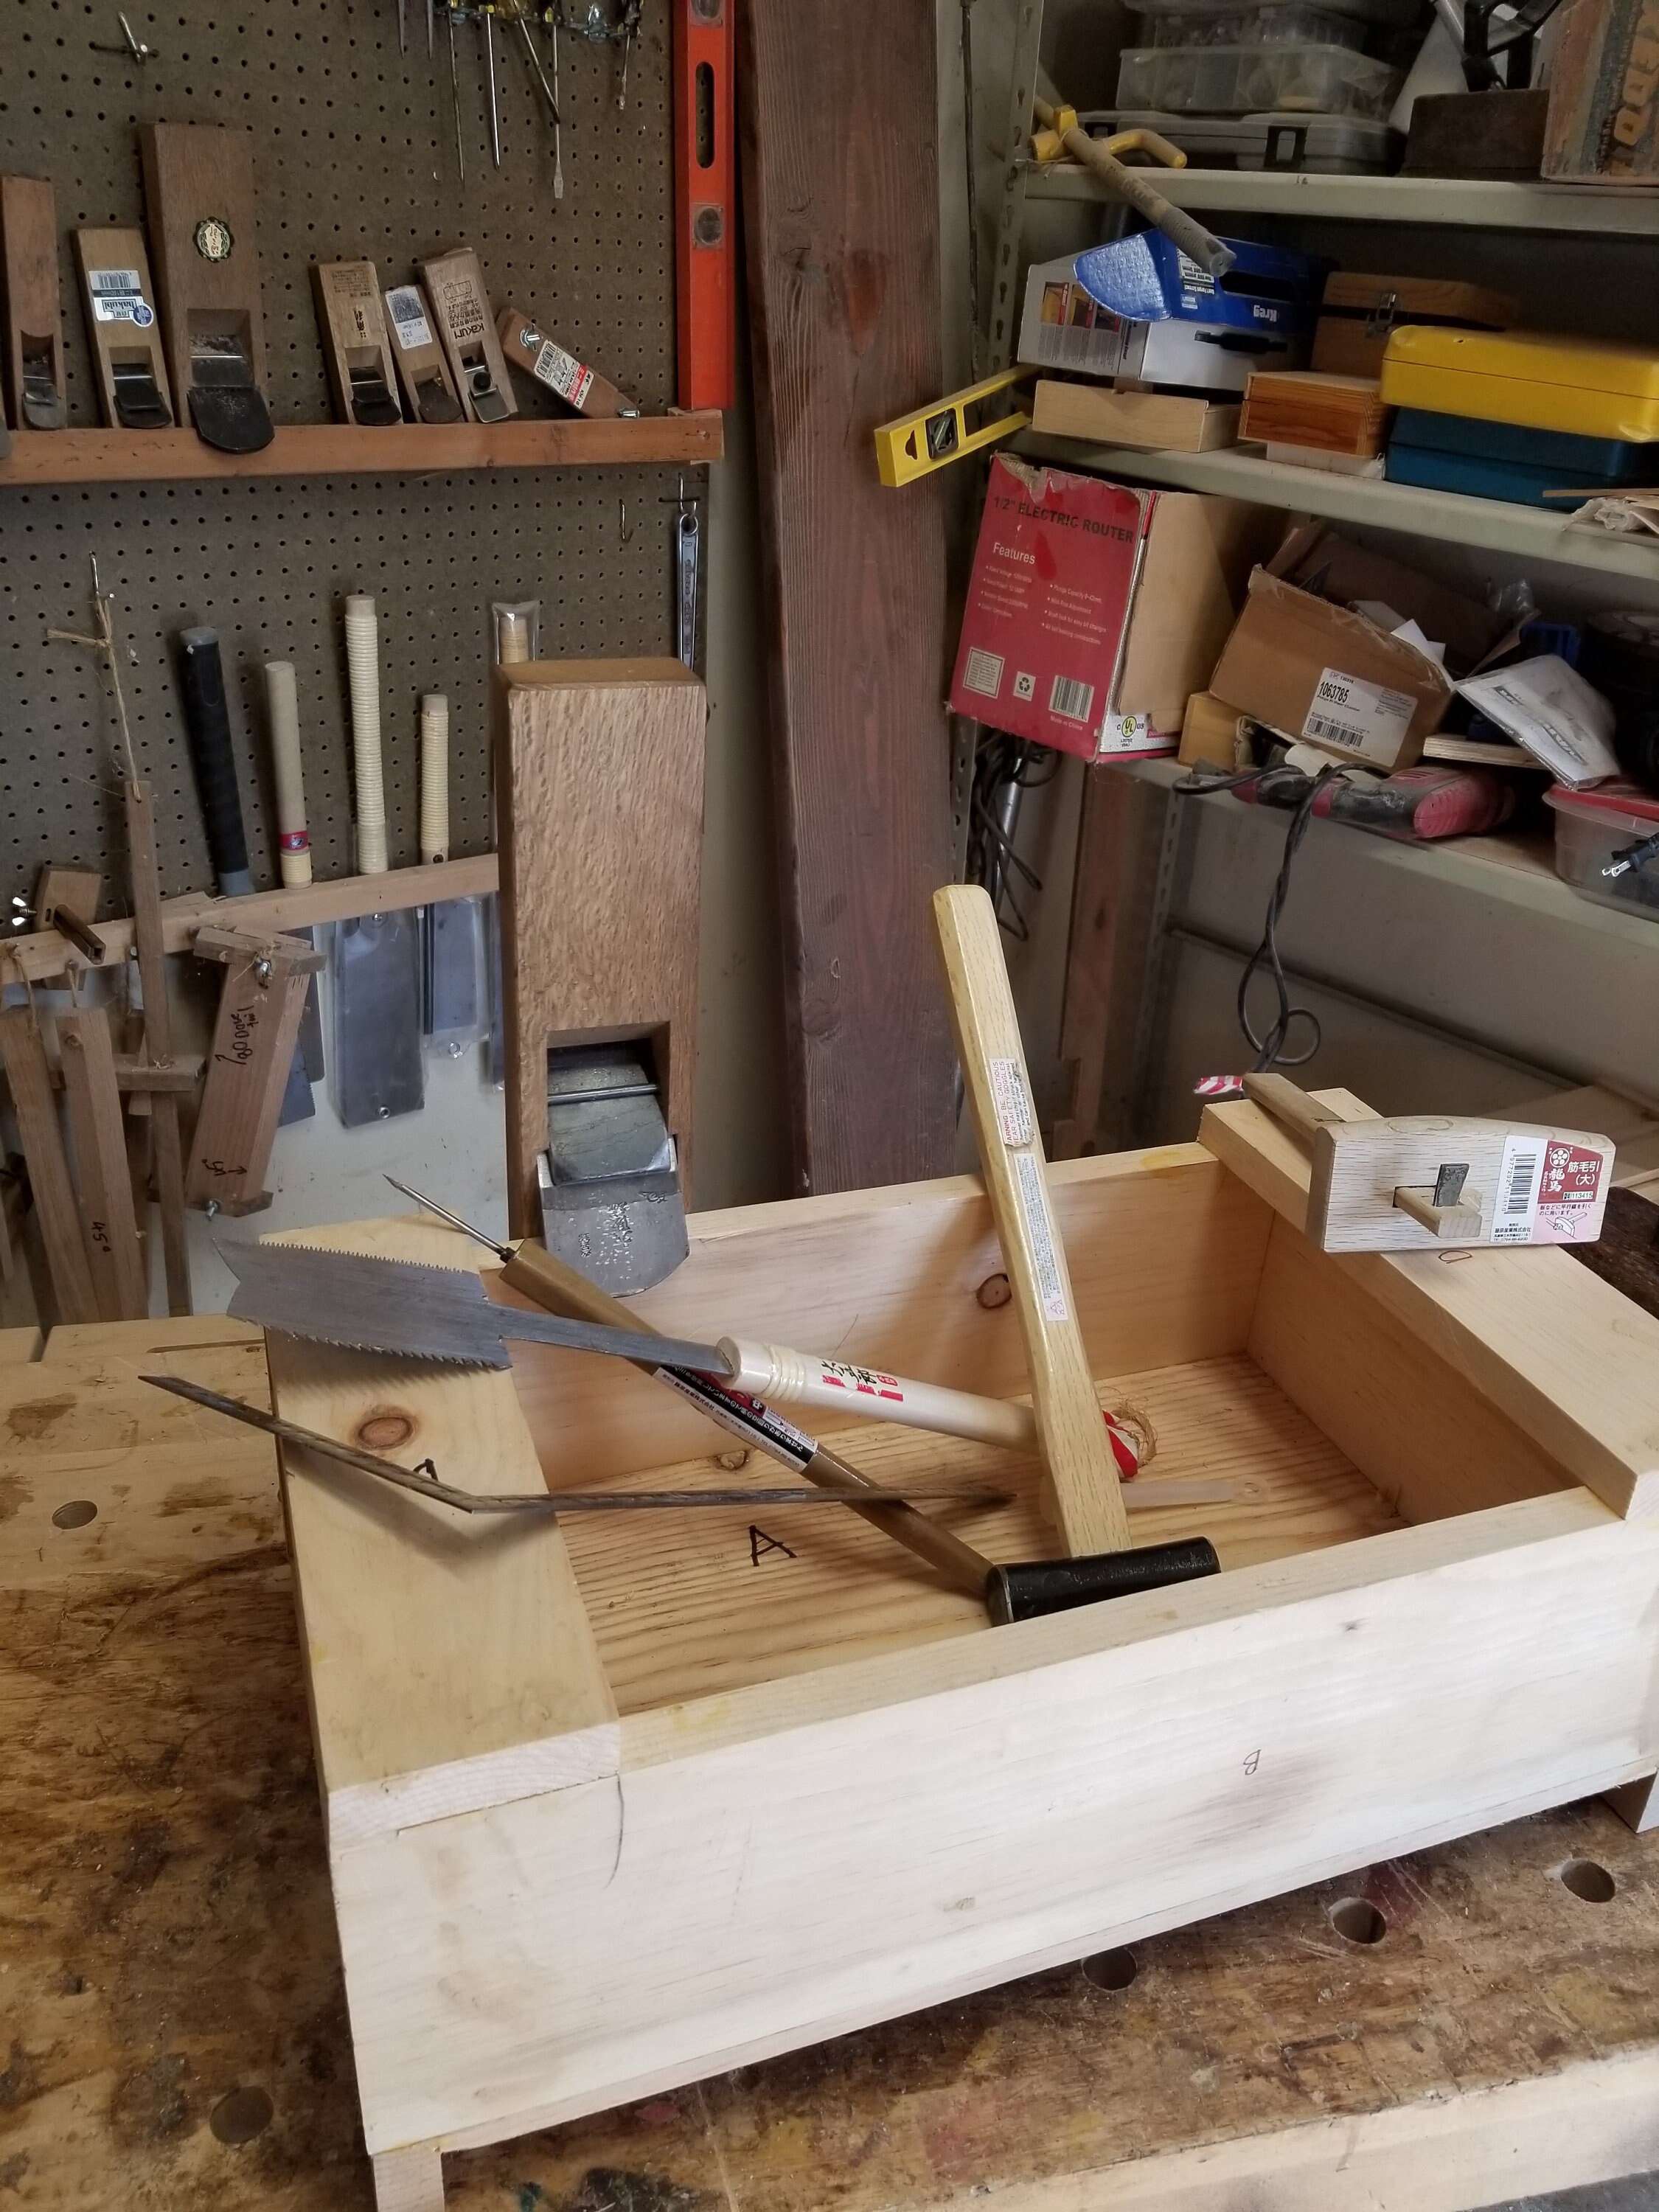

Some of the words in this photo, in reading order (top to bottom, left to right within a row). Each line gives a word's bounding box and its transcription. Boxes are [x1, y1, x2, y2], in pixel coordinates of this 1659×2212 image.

[1253, 305, 1278, 322] Kreg
[993, 495, 1015, 510] 1/2"
[1018, 502, 1079, 528] ELECTRIC
[1082, 518, 1134, 543] ROUTER
[992, 542, 1036, 565] Features
[1319, 681, 1349, 703] 1063785
[992, 1061, 1004, 1096] CAUTIOUS
[998, 1061, 1010, 1094] GOGGLES
[1000, 1100, 1006, 1110] BE
[1005, 1095, 1016, 1124] SAFETY
[1003, 1115, 1013, 1144] ARNING
[1011, 1126, 1020, 1145] EAR
[1568, 1161, 1600, 1172] 筋毛引
[748, 1524, 798, 1567] A
